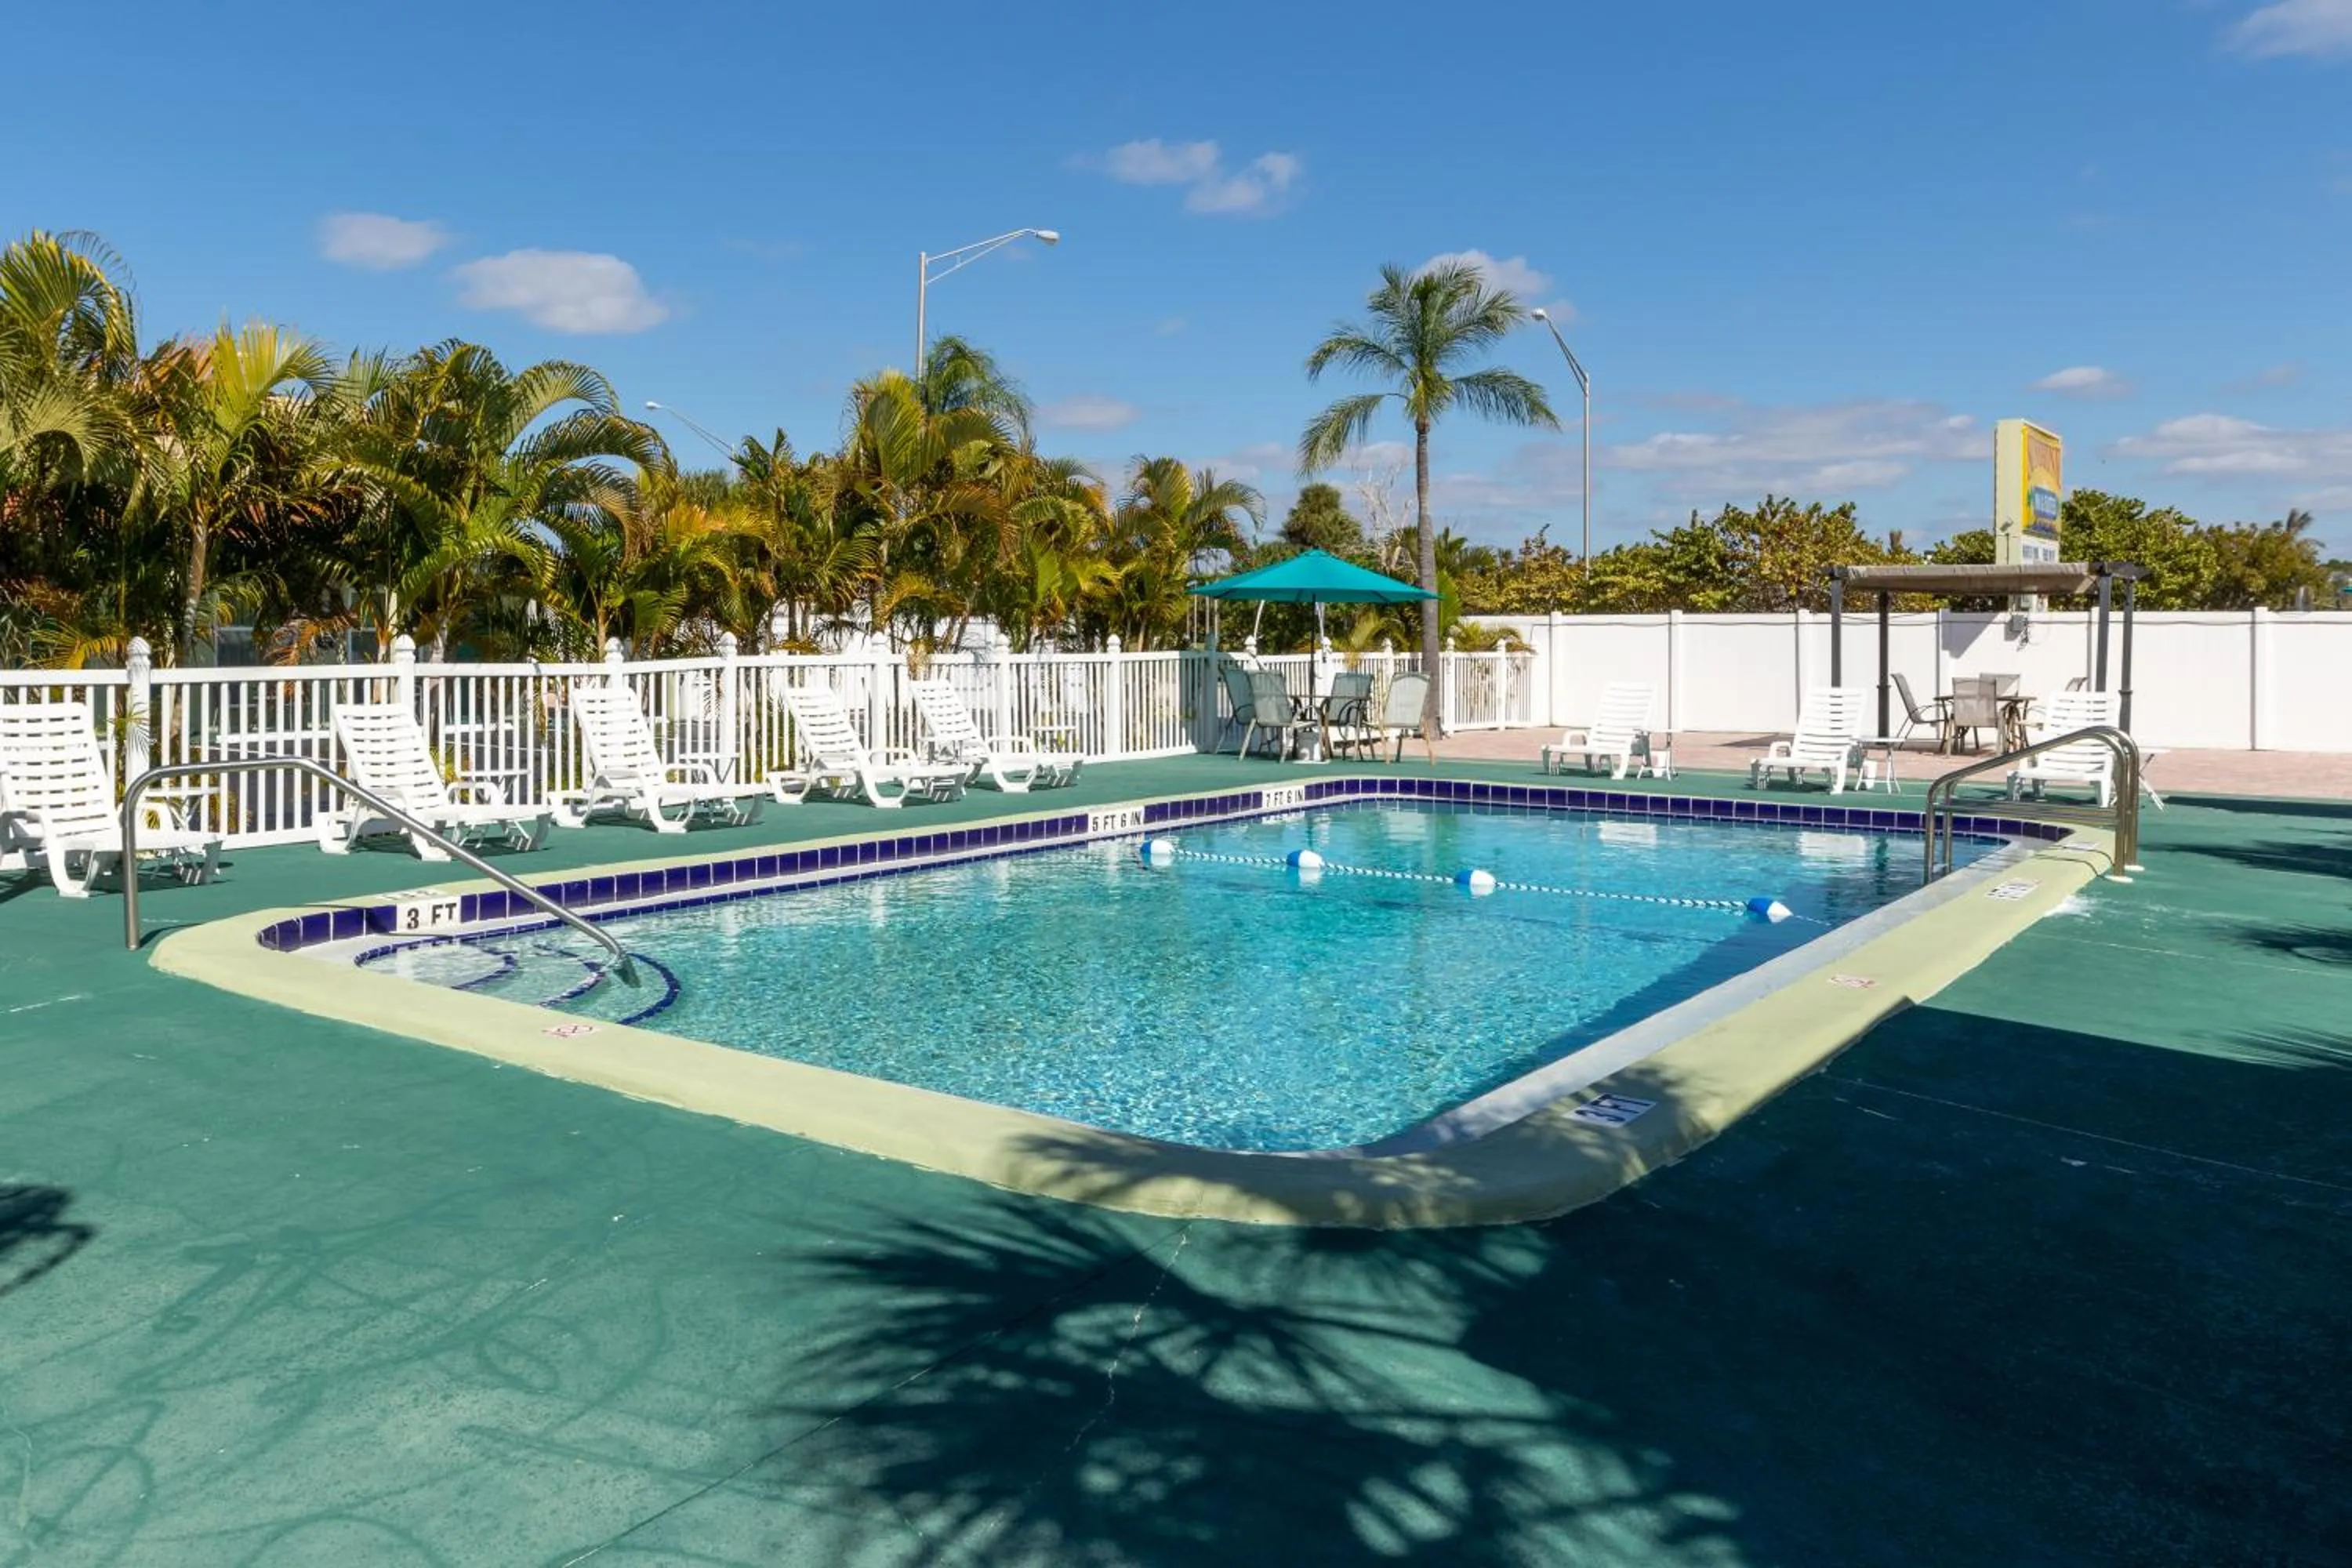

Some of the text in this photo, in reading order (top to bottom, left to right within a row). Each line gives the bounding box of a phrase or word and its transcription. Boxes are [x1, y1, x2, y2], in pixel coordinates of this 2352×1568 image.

[1274, 791, 1283, 807] FT
[1287, 789, 1293, 804] 6
[1294, 789, 1304, 804] IN
[1092, 811, 1142, 832] 5 FT 6 IN
[407, 902, 456, 929] 3 FT
